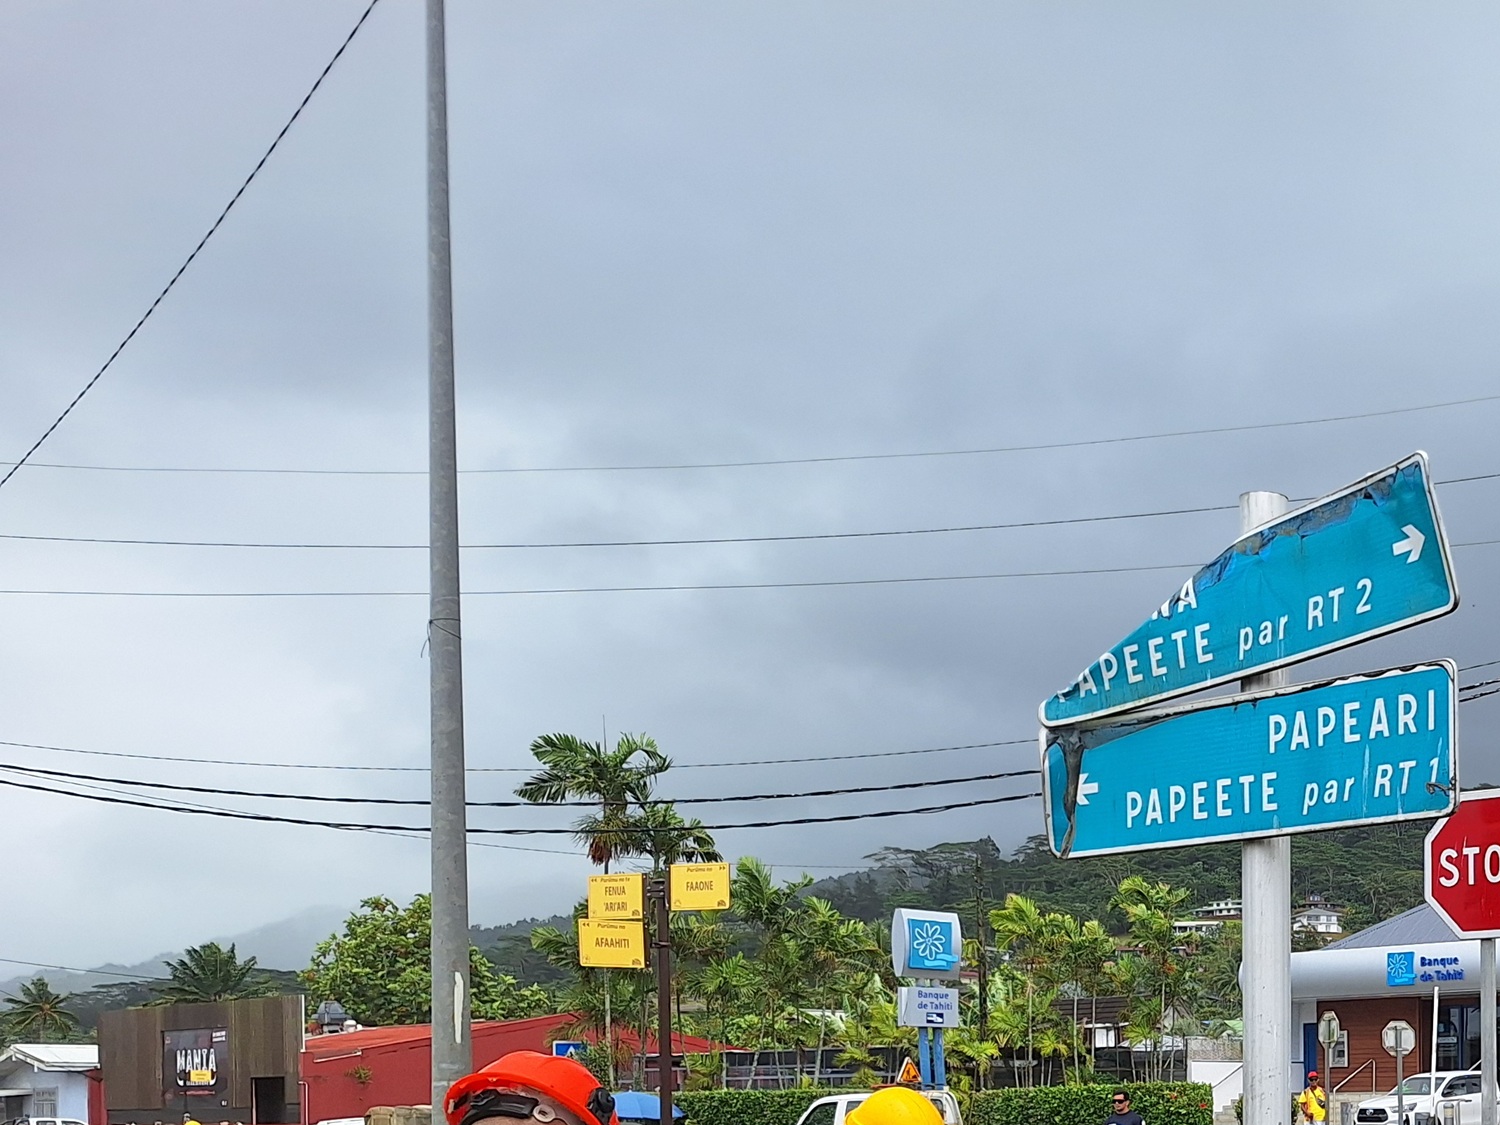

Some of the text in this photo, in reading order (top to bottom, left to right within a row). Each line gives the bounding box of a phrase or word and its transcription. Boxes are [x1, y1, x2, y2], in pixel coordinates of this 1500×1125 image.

[1057, 577, 1373, 703] APEETE par RT 2
[1268, 689, 1435, 754] PAPEARI
[1126, 756, 1440, 829] PAPEETE par RT 1
[604, 886, 626, 896] FENUA
[686, 881, 714, 891] FAAONE
[595, 937, 630, 949] AFAAHITI
[1420, 956, 1460, 968] Banque
[1420, 969, 1464, 982] de Tahiti
[917, 990, 950, 1001] Banque
[917, 1001, 953, 1010] de Tahiti
[176, 1048, 217, 1074] MANIA
